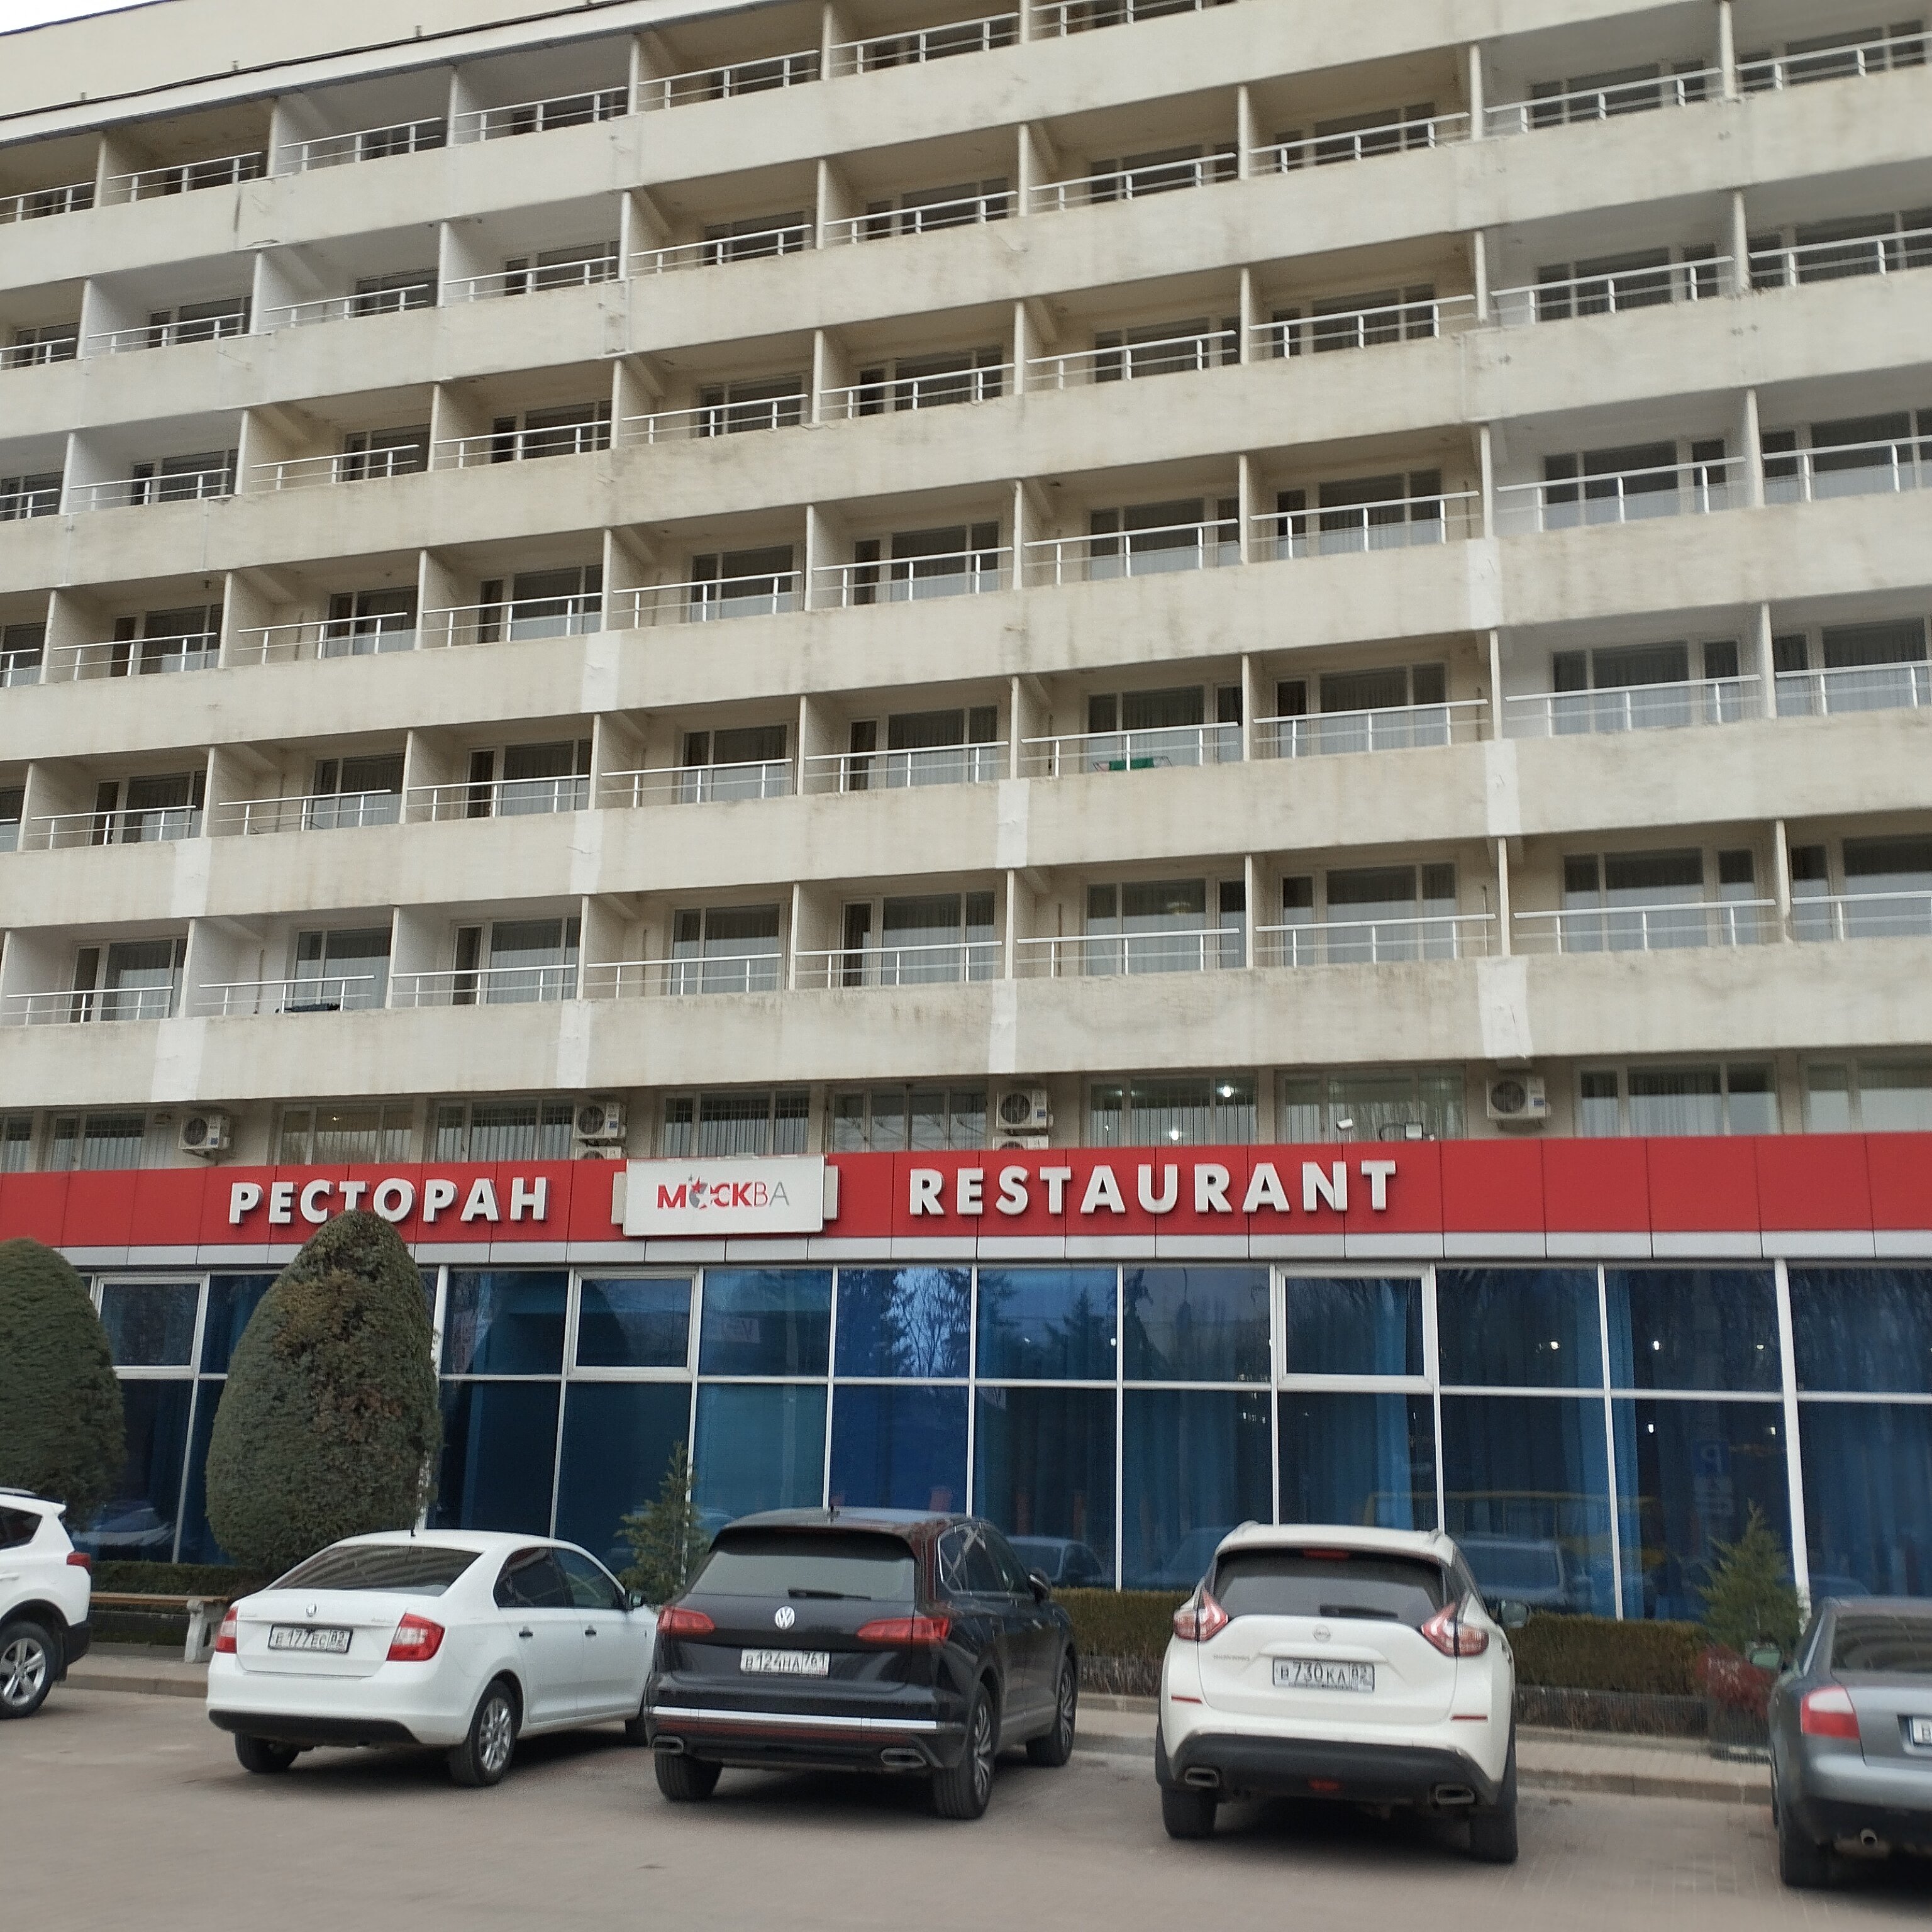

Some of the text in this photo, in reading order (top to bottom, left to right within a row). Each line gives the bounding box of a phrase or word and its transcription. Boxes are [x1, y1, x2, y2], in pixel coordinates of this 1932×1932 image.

[229, 1177, 549, 1224] РЕСТОРАН
[657, 1176, 790, 1209] МОСКВА
[909, 1160, 1397, 1215] RESTAURANT
